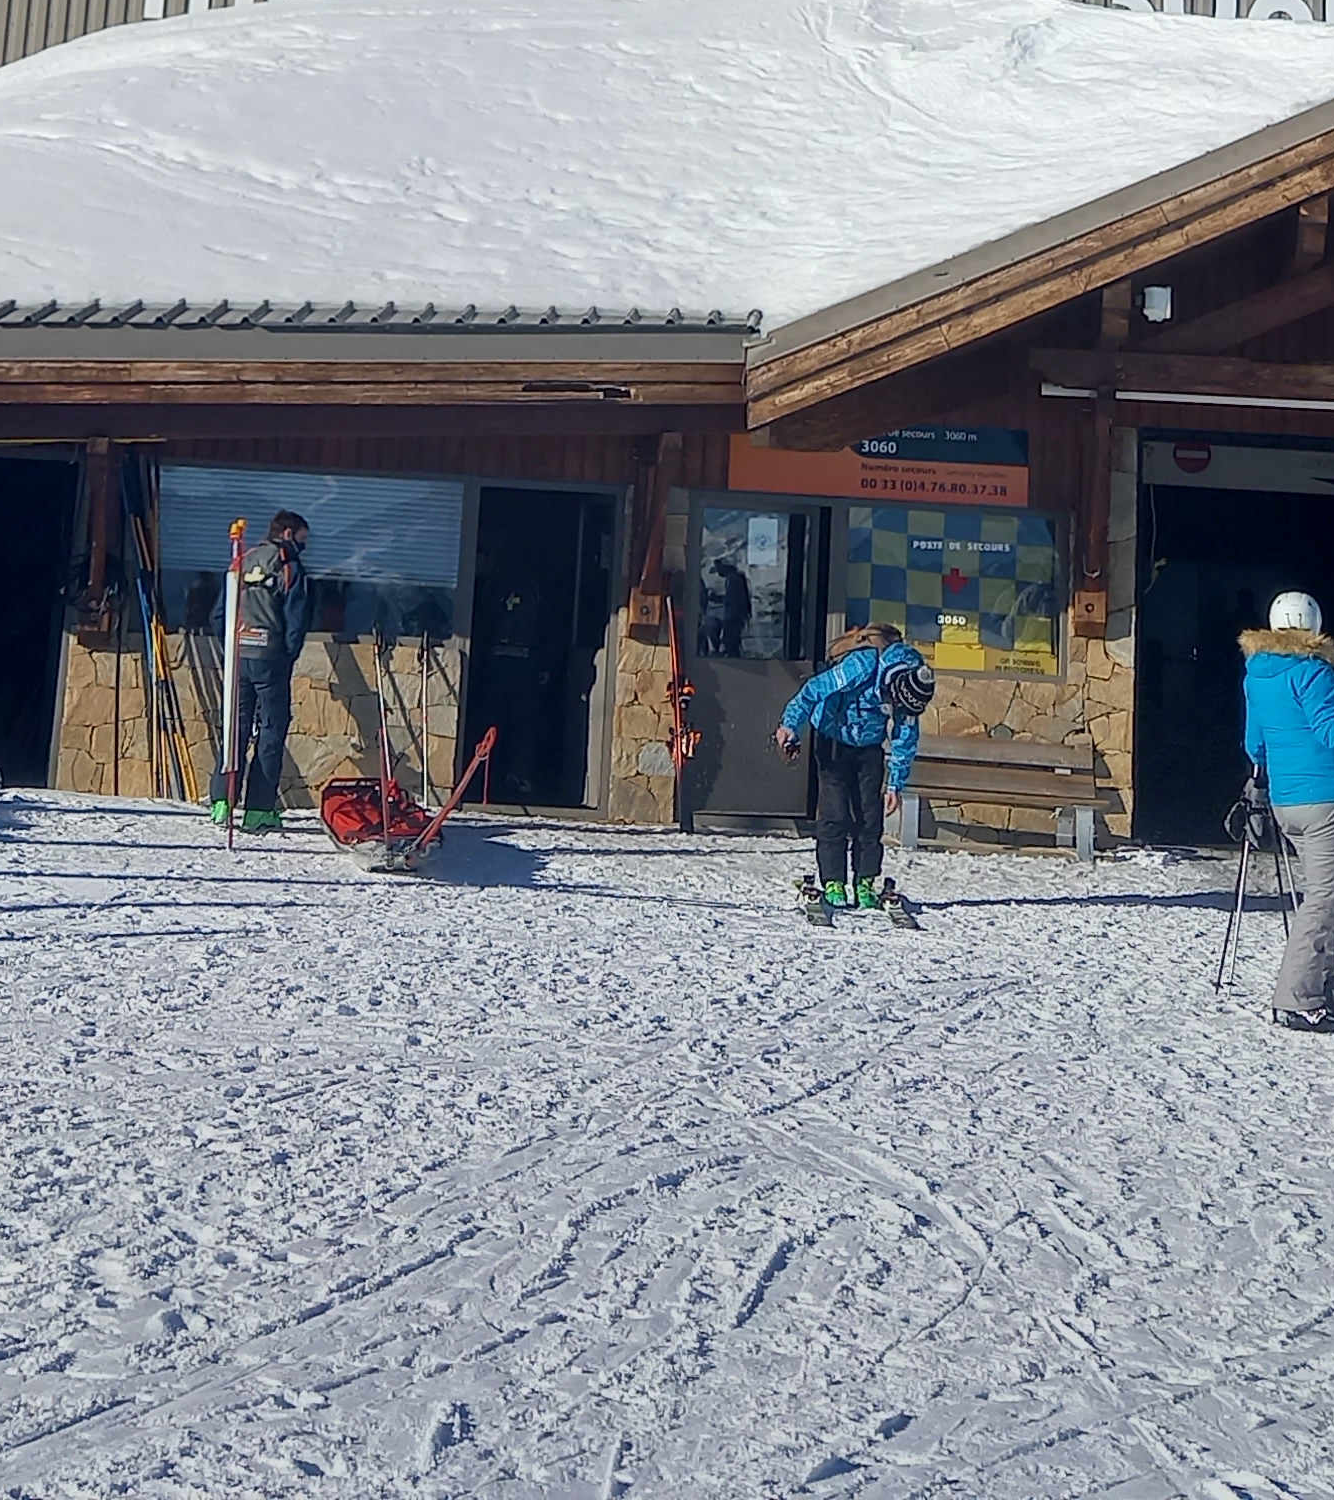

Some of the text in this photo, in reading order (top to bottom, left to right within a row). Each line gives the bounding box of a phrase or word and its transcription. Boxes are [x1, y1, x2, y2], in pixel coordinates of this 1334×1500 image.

[901, 430, 936, 440] secours
[944, 430, 967, 441] 3060
[968, 433, 978, 442] m
[860, 440, 898, 454] 3060
[860, 462, 899, 473] Numéro
[901, 465, 937, 475] secours
[860, 478, 877, 490] 00
[881, 479, 897, 491] 33
[913, 540, 1011, 552] POSTE DE SECOURS
[937, 614, 966, 626] 3060
